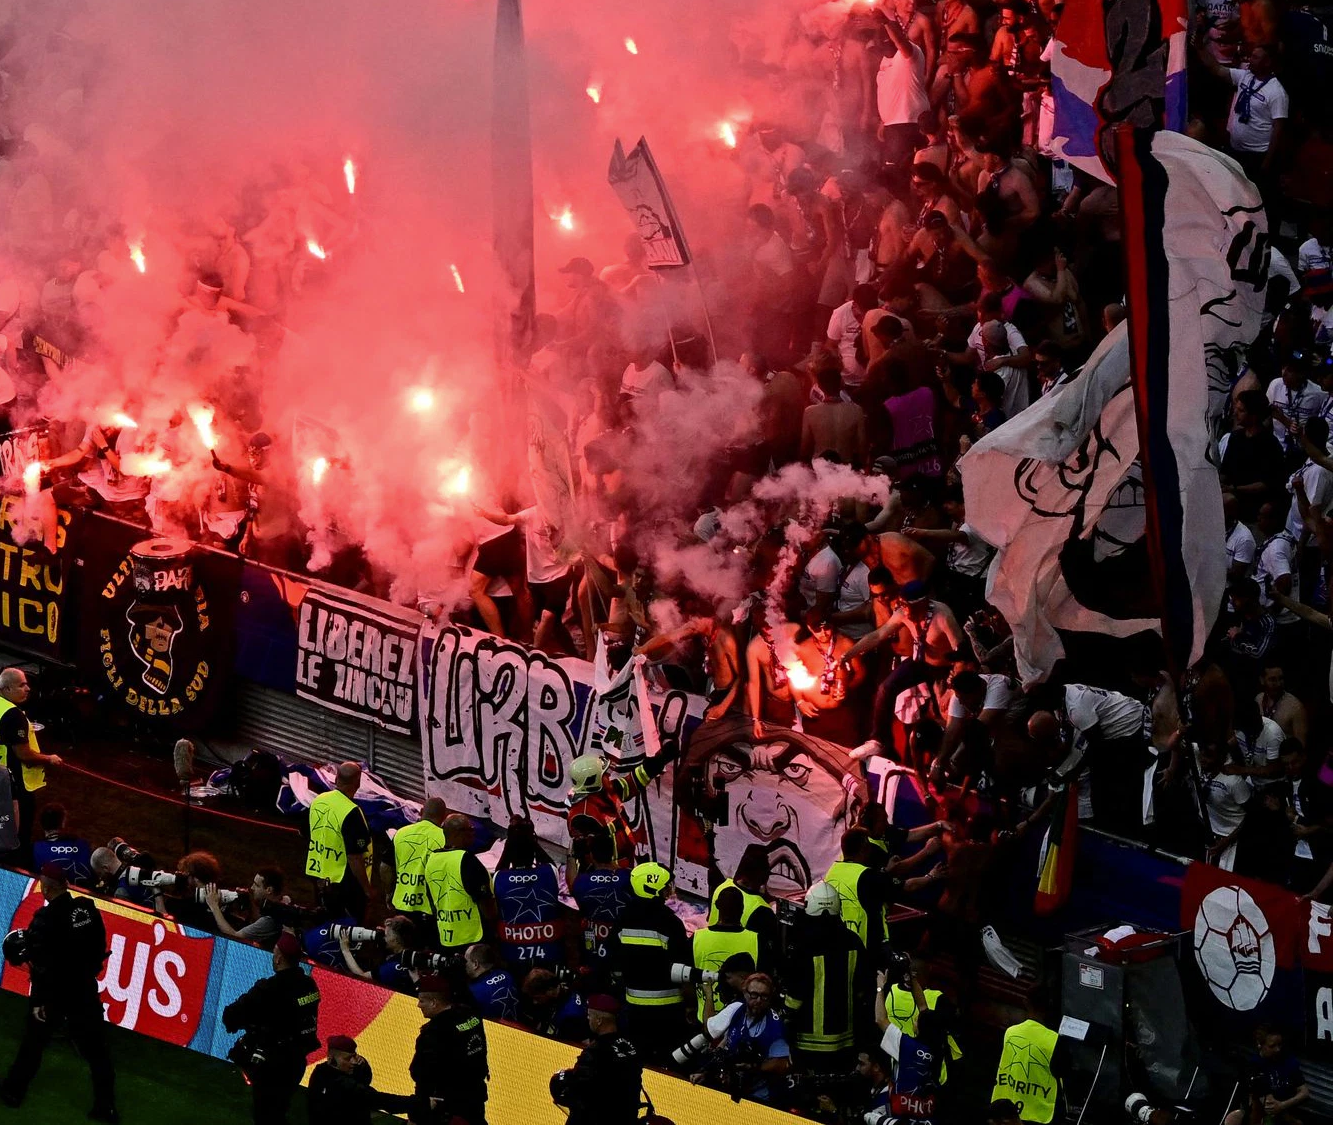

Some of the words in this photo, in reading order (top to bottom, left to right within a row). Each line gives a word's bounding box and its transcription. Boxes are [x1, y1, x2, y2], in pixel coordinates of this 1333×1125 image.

[298, 601, 417, 686] LIBEREZ
[100, 627, 124, 690] FIGLI
[296, 650, 322, 689] LE
[186, 661, 209, 702] SUD
[125, 687, 184, 716] DELLA
[50, 845, 79, 855] oppo
[508, 874, 539, 884] oppo
[646, 874, 659, 884] RV
[402, 892, 424, 906] 483
[504, 924, 555, 941] PHOTO
[517, 945, 546, 960] 274
